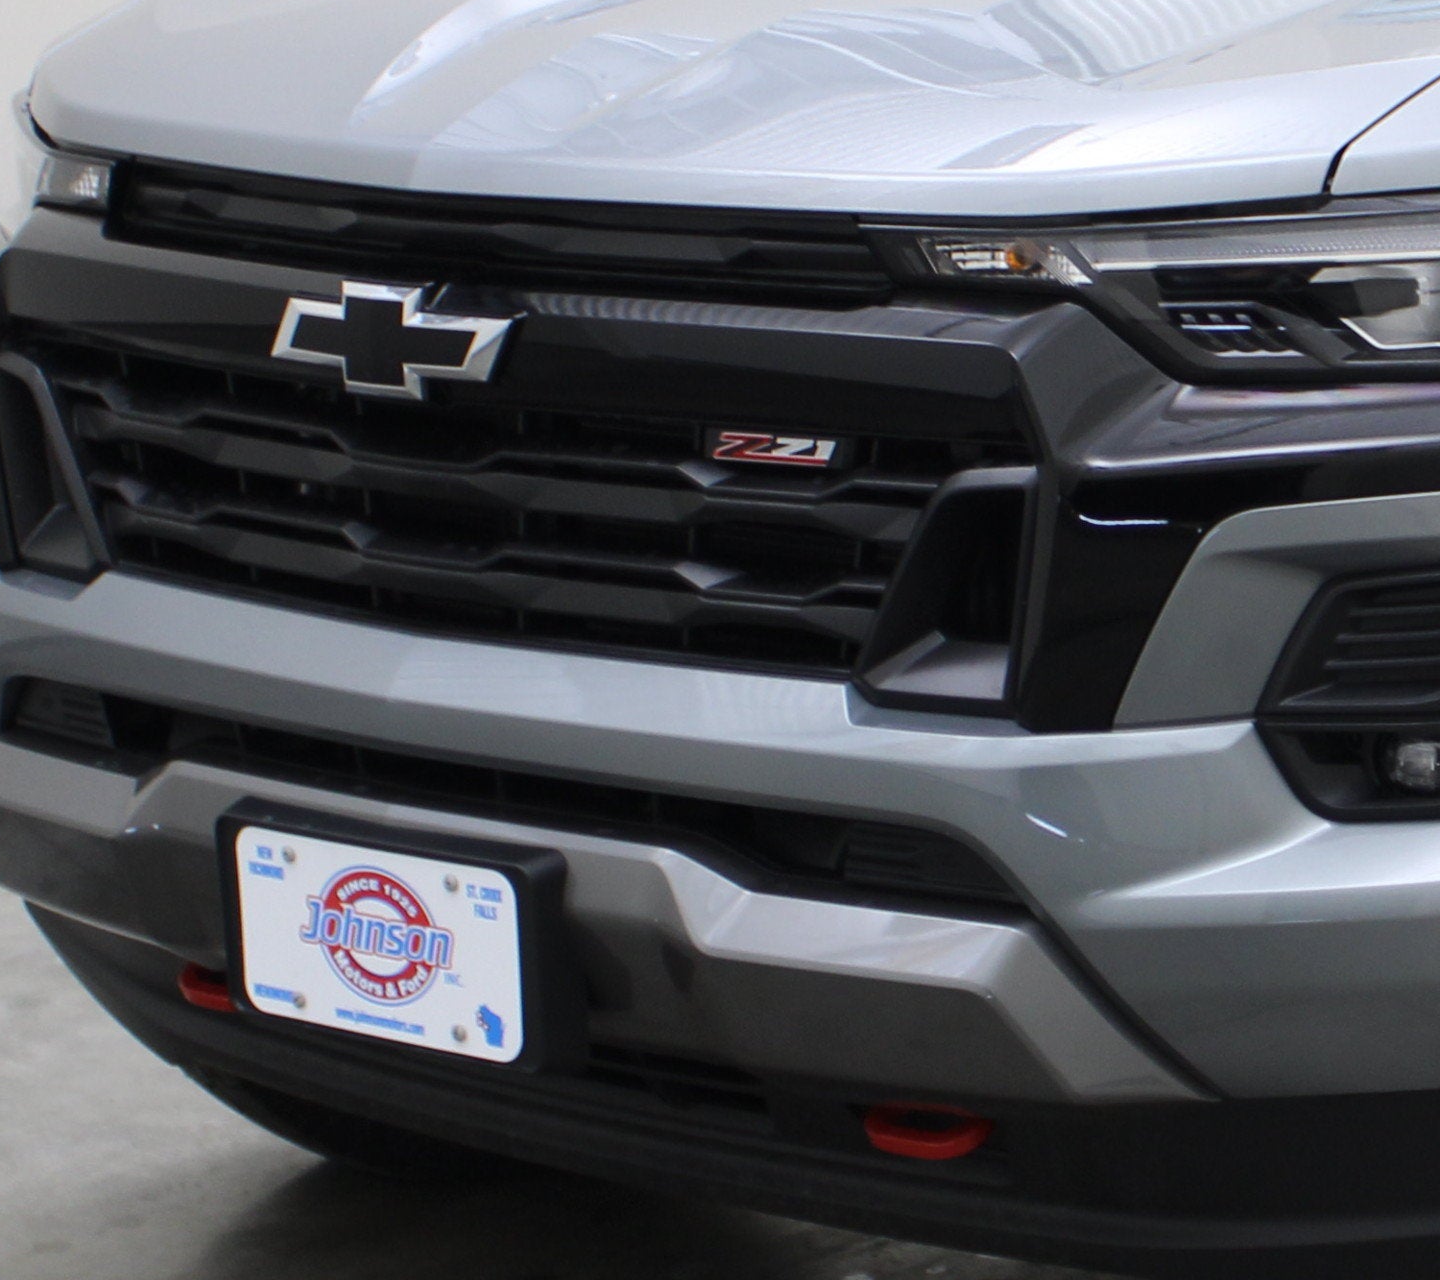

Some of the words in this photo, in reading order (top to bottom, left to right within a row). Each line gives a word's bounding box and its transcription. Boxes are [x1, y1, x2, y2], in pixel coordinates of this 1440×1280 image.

[713, 431, 836, 467] Z71
[336, 877, 379, 901] SINCE
[301, 895, 453, 969] Johnson
[333, 949, 383, 997] Motors
[385, 981, 398, 999] &
[398, 963, 429, 997] Ford
